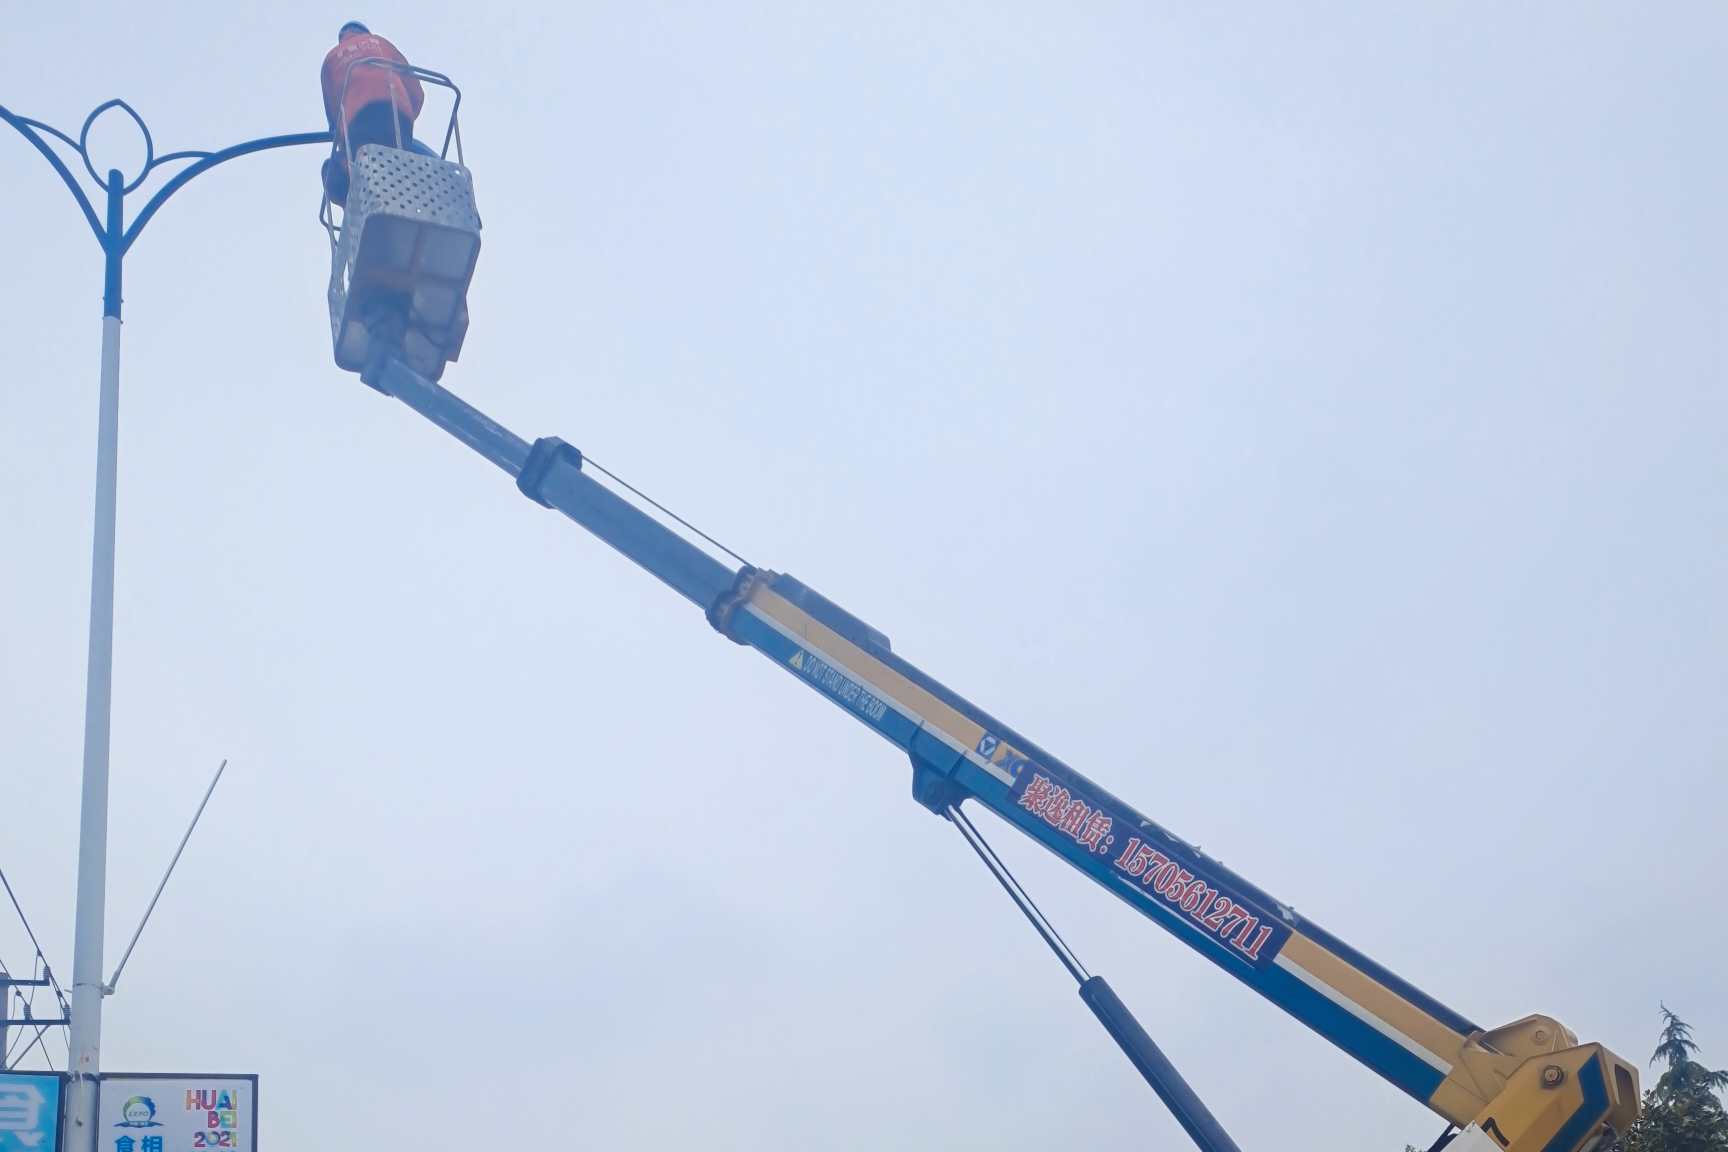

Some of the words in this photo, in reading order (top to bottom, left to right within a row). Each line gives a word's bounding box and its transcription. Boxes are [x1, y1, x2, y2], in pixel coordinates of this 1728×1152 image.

[1113, 838, 1273, 960] 15705612711
[185, 1089, 238, 1111] HUAI
[193, 1131, 238, 1148] 2021
